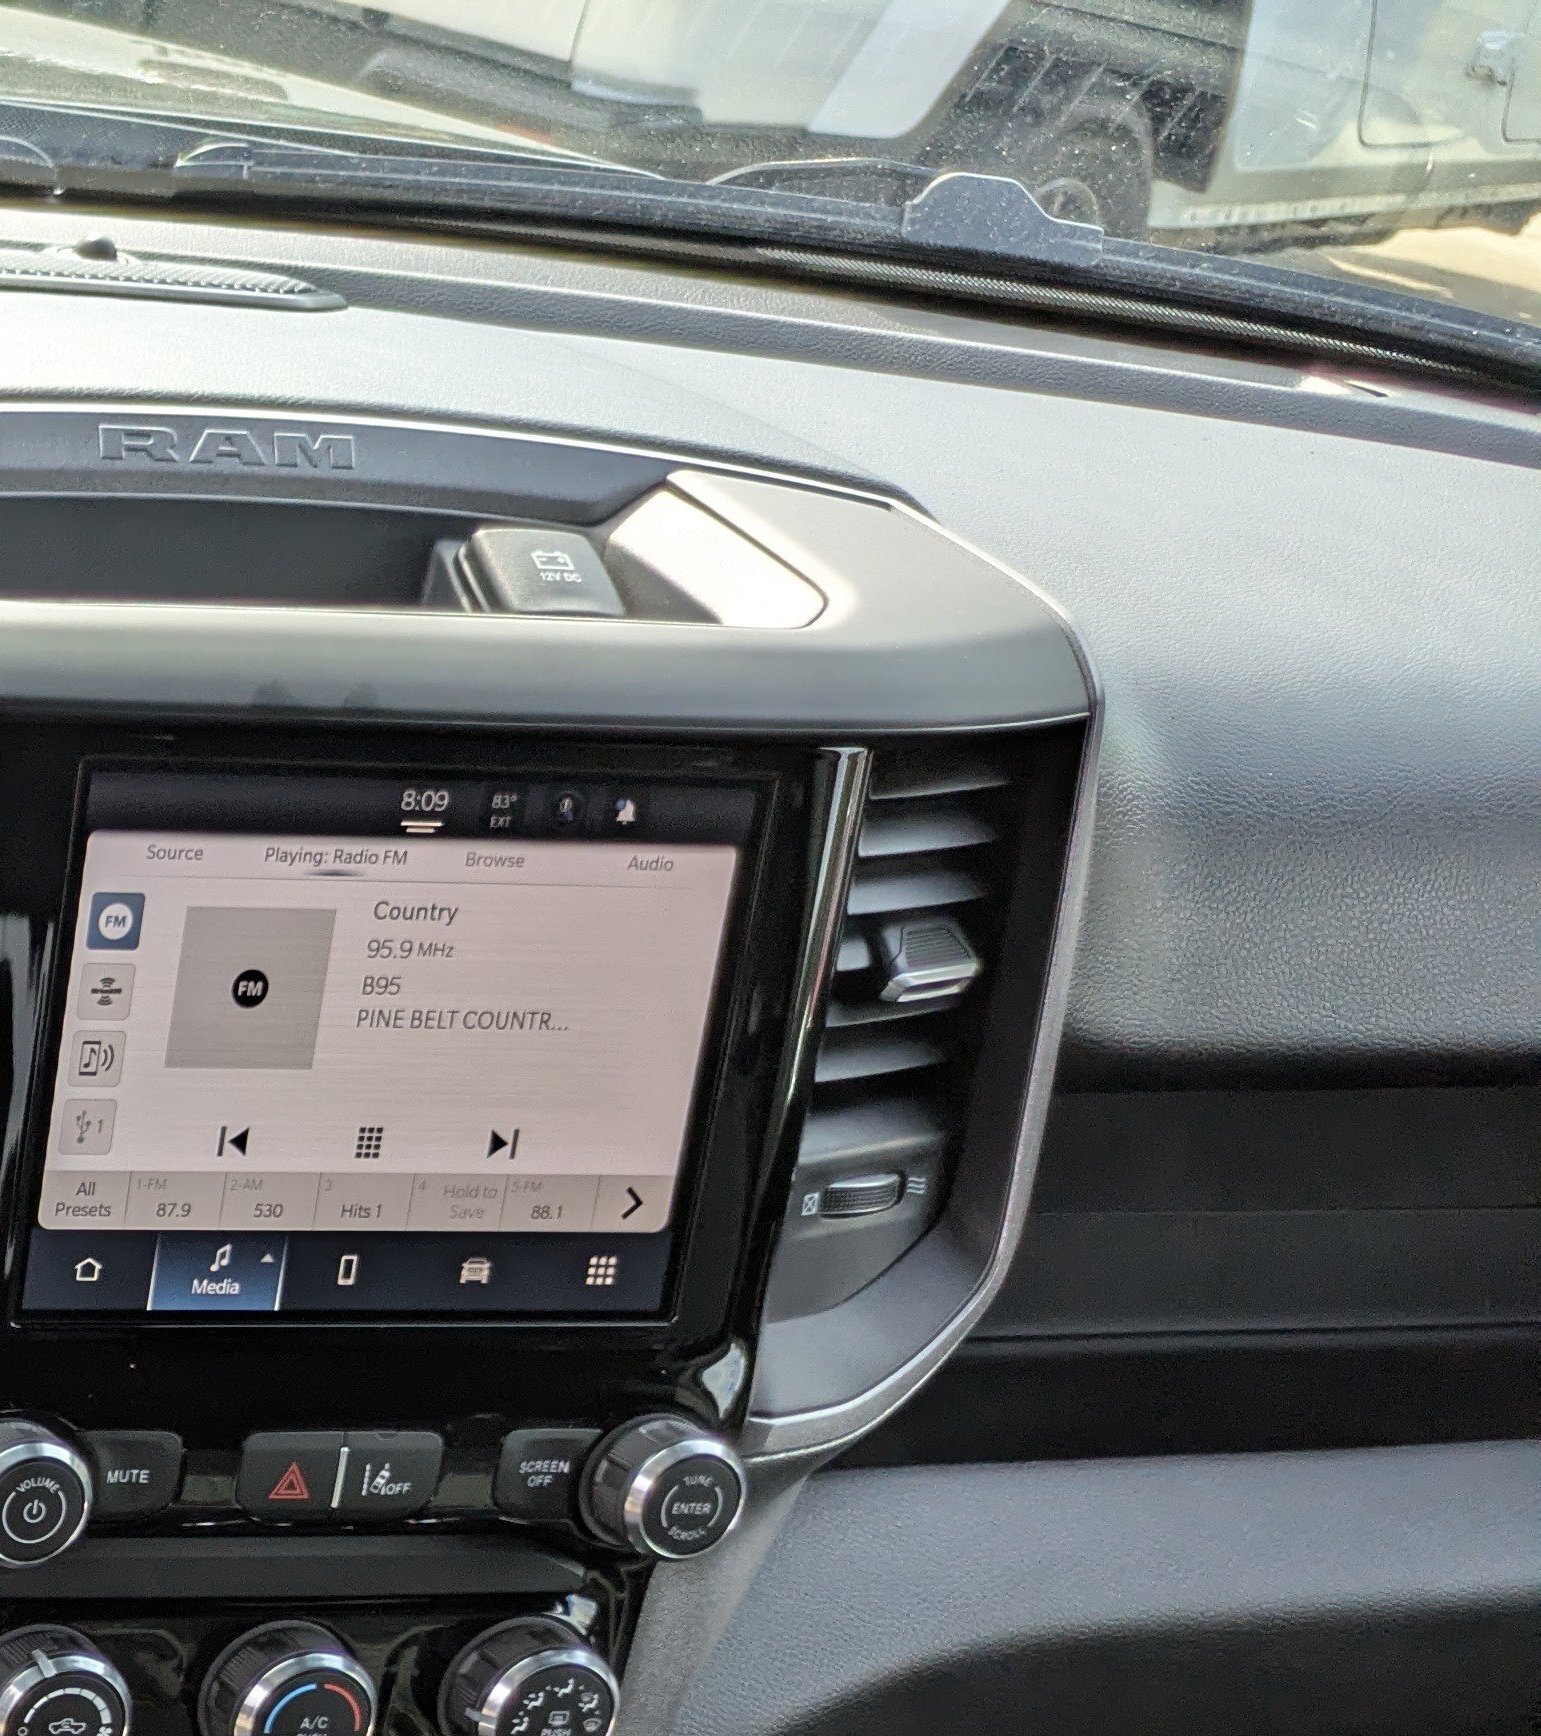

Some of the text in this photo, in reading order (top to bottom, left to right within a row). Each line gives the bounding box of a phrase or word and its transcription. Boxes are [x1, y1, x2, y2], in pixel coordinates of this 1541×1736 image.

[98, 424, 357, 471] RAM
[401, 790, 449, 812] 8:09
[146, 844, 203, 861] Source
[265, 847, 408, 866] Playing: Radio FM
[466, 851, 525, 868] Browse
[627, 855, 674, 872] Audio
[373, 901, 459, 926] Country
[104, 915, 127, 928] FM
[367, 939, 455, 959] 95.9 MHz
[237, 981, 263, 997] FM
[362, 976, 402, 996] B95
[356, 1009, 405, 1029] PINE
[410, 1009, 459, 1029] BELT
[76, 1182, 95, 1196] All
[443, 1184, 498, 1199] Hold to
[55, 1202, 111, 1217] Presets
[156, 1203, 191, 1218] 87.9
[253, 1204, 284, 1218] 530
[340, 1205, 382, 1219] Hits 1
[449, 1205, 485, 1219] Save
[531, 1205, 564, 1220] 88.1
[191, 1279, 241, 1296] Media
[519, 1460, 571, 1475] SCREEN
[106, 1469, 150, 1485] MUTE
[528, 1474, 553, 1488] OFF
[16, 1478, 62, 1494] VOLUME
[386, 1483, 412, 1495] OFF
[672, 1503, 711, 1515] ENTER
[300, 1716, 328, 1730] A/C
